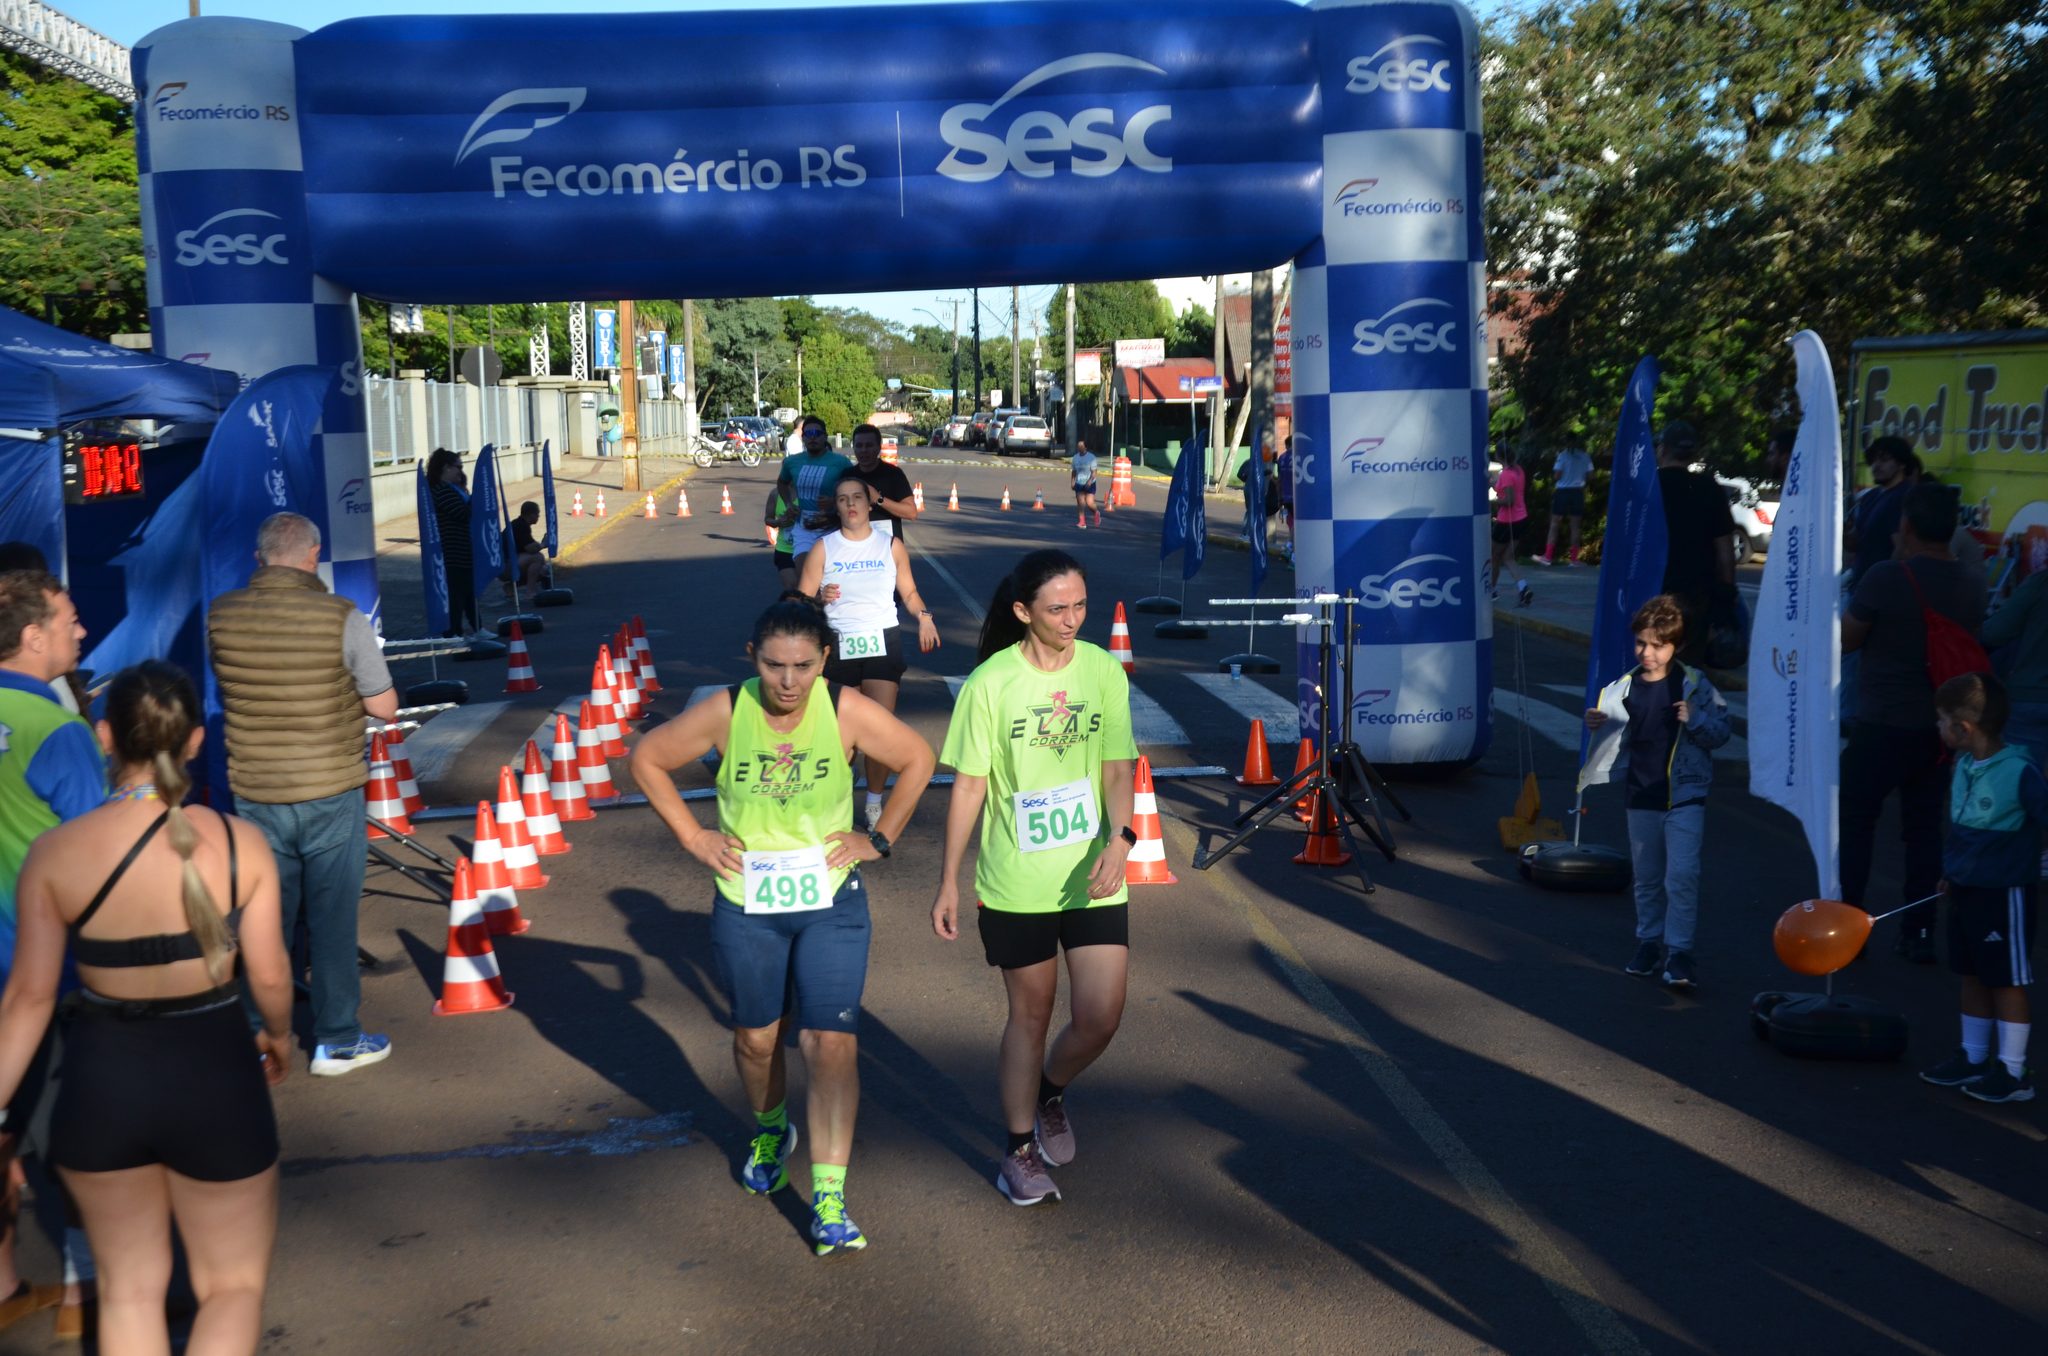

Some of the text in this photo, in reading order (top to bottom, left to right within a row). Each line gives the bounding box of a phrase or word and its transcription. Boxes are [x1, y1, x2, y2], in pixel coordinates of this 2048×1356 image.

[1345, 55, 1452, 94] Sesc
[159, 103, 290, 122] Fecomércio RS
[935, 102, 1174, 183] Sesc
[490, 144, 867, 198] Fecomércio RS
[1344, 198, 1465, 218] Fecomércio RS
[175, 228, 289, 267] Sesc
[599, 328, 612, 367] URI
[1306, 334, 1323, 350] RS
[1351, 318, 1457, 356] Sesc
[1861, 365, 1949, 453] Food
[1294, 453, 1316, 485] sc
[1351, 456, 1448, 474] Fecomércio
[1452, 455, 1470, 471] RS
[1786, 451, 1802, 498] Sesc
[271, 469, 287, 507] Sesc
[488, 518, 501, 567] Sesc
[1359, 574, 1462, 610] Sesc
[846, 635, 880, 656] 393
[1784, 525, 1800, 788] Fecomércio RS Sindicatos
[1010, 712, 1102, 740] ELAS
[1357, 708, 1454, 725] Fecomércio
[1457, 706, 1474, 722] RS
[1029, 733, 1090, 747] CORREM
[735, 757, 831, 783] ELAS
[751, 782, 815, 794] CORREM
[1021, 796, 1049, 809] Sesc
[1028, 801, 1090, 846] 504
[751, 861, 778, 871] Sesc
[755, 872, 821, 909] 498
